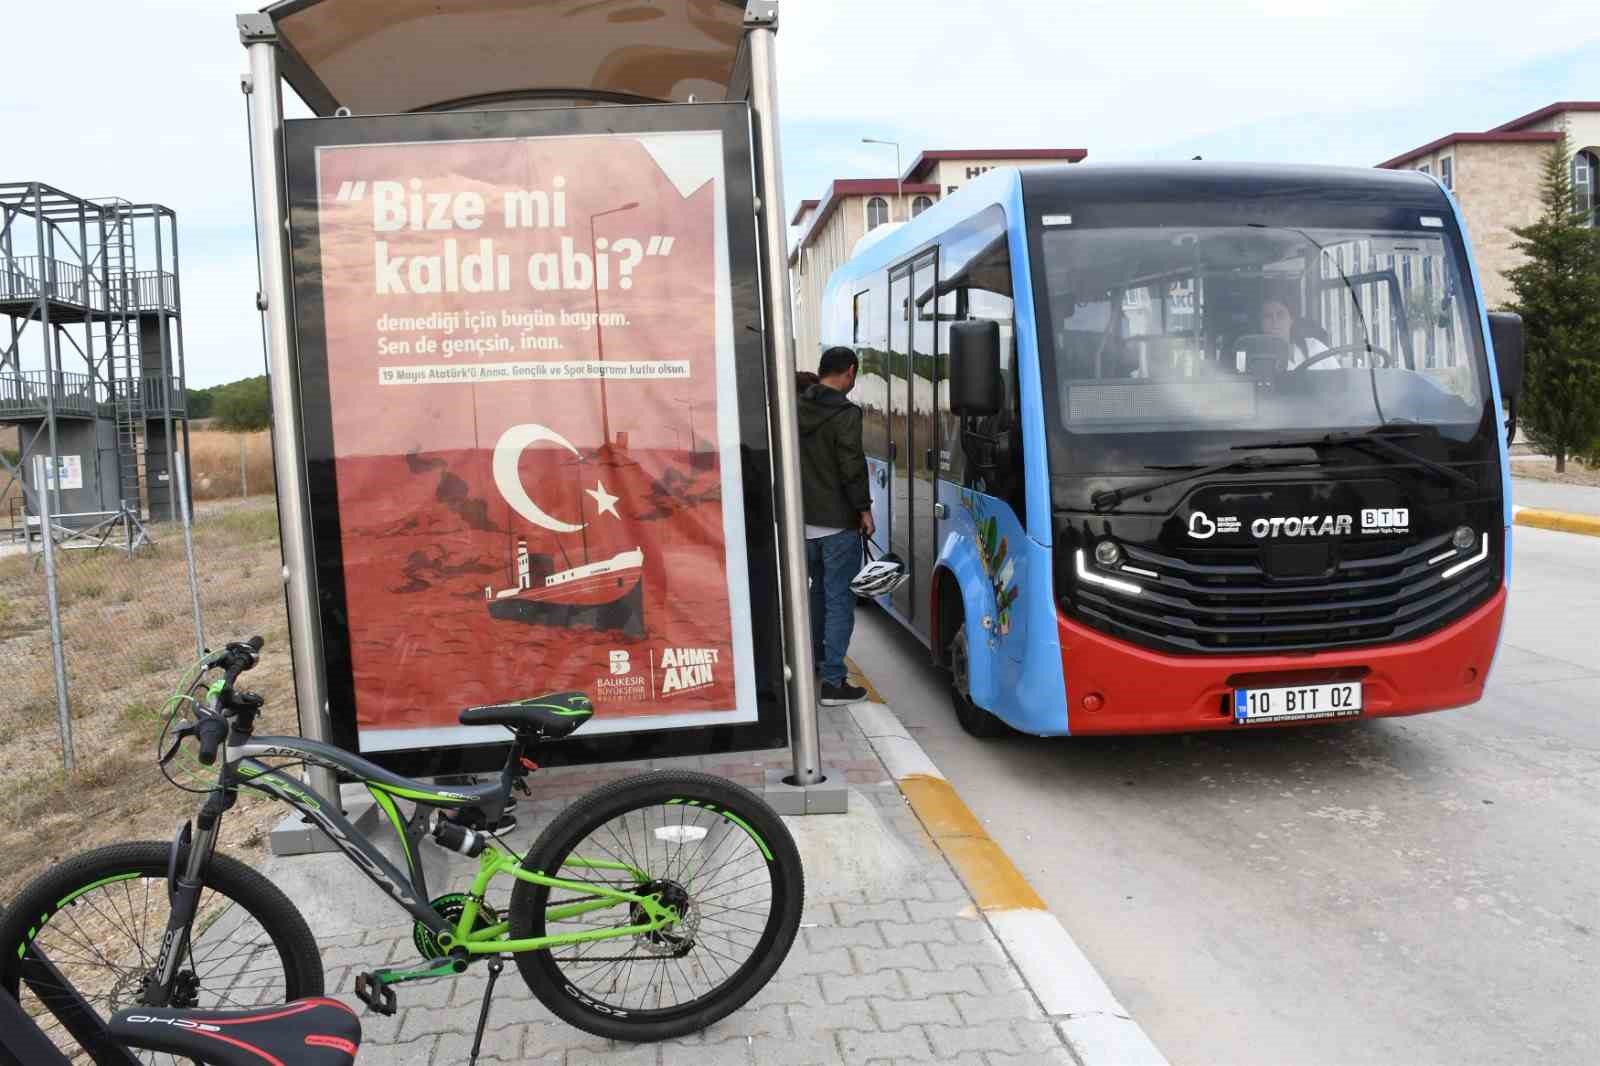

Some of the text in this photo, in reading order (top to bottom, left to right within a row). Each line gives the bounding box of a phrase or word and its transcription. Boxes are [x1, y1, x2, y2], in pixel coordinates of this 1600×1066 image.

[504, 175, 566, 229] mi
[374, 238, 511, 295] kaldı
[376, 308, 631, 335] demediği için bugün bayram.
[377, 331, 564, 358] Sen de gençsin, inan.
[383, 370, 395, 381] 19
[550, 367, 562, 375] ve
[564, 364, 585, 377] Spor
[629, 363, 656, 375] kutlu
[1251, 514, 1353, 538] OTOKAR
[1363, 510, 1406, 525] BTT
[661, 647, 719, 668] AHMET
[661, 664, 713, 694] AKIN
[1249, 686, 1353, 714] 10 BTT 02
